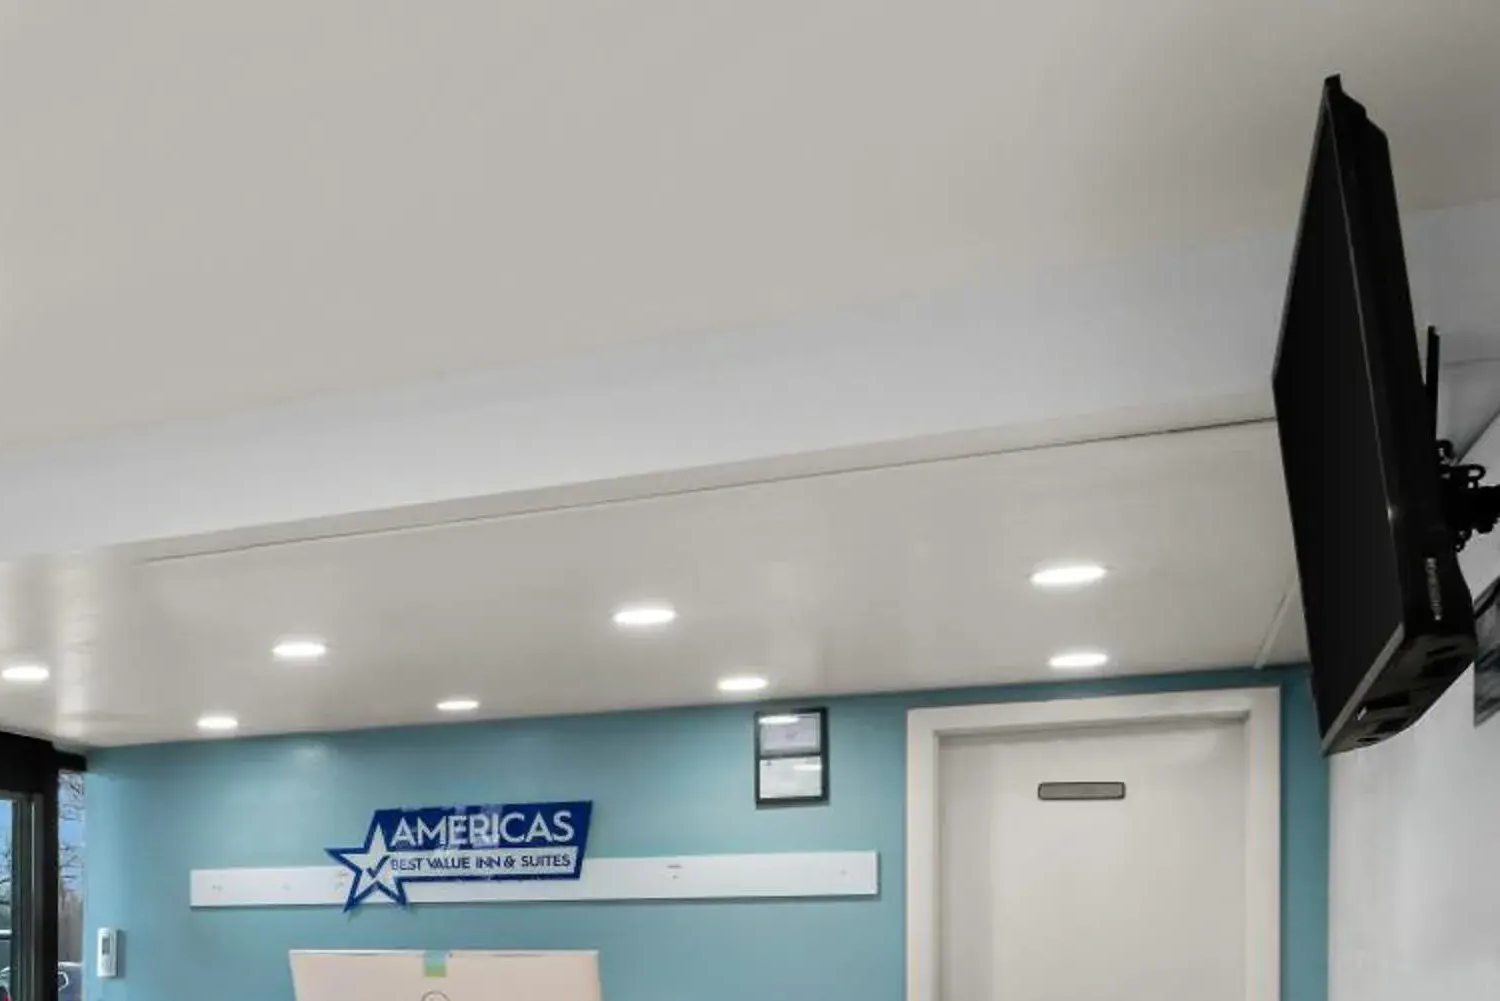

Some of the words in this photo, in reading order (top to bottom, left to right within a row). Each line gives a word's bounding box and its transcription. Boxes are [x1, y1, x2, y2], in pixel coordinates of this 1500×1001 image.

[390, 810, 575, 847] AMERICAS
[391, 857, 422, 870] BEST
[427, 856, 470, 869] VALUE
[475, 855, 500, 869] INN
[503, 855, 515, 869] &
[521, 854, 571, 867] SUITES
